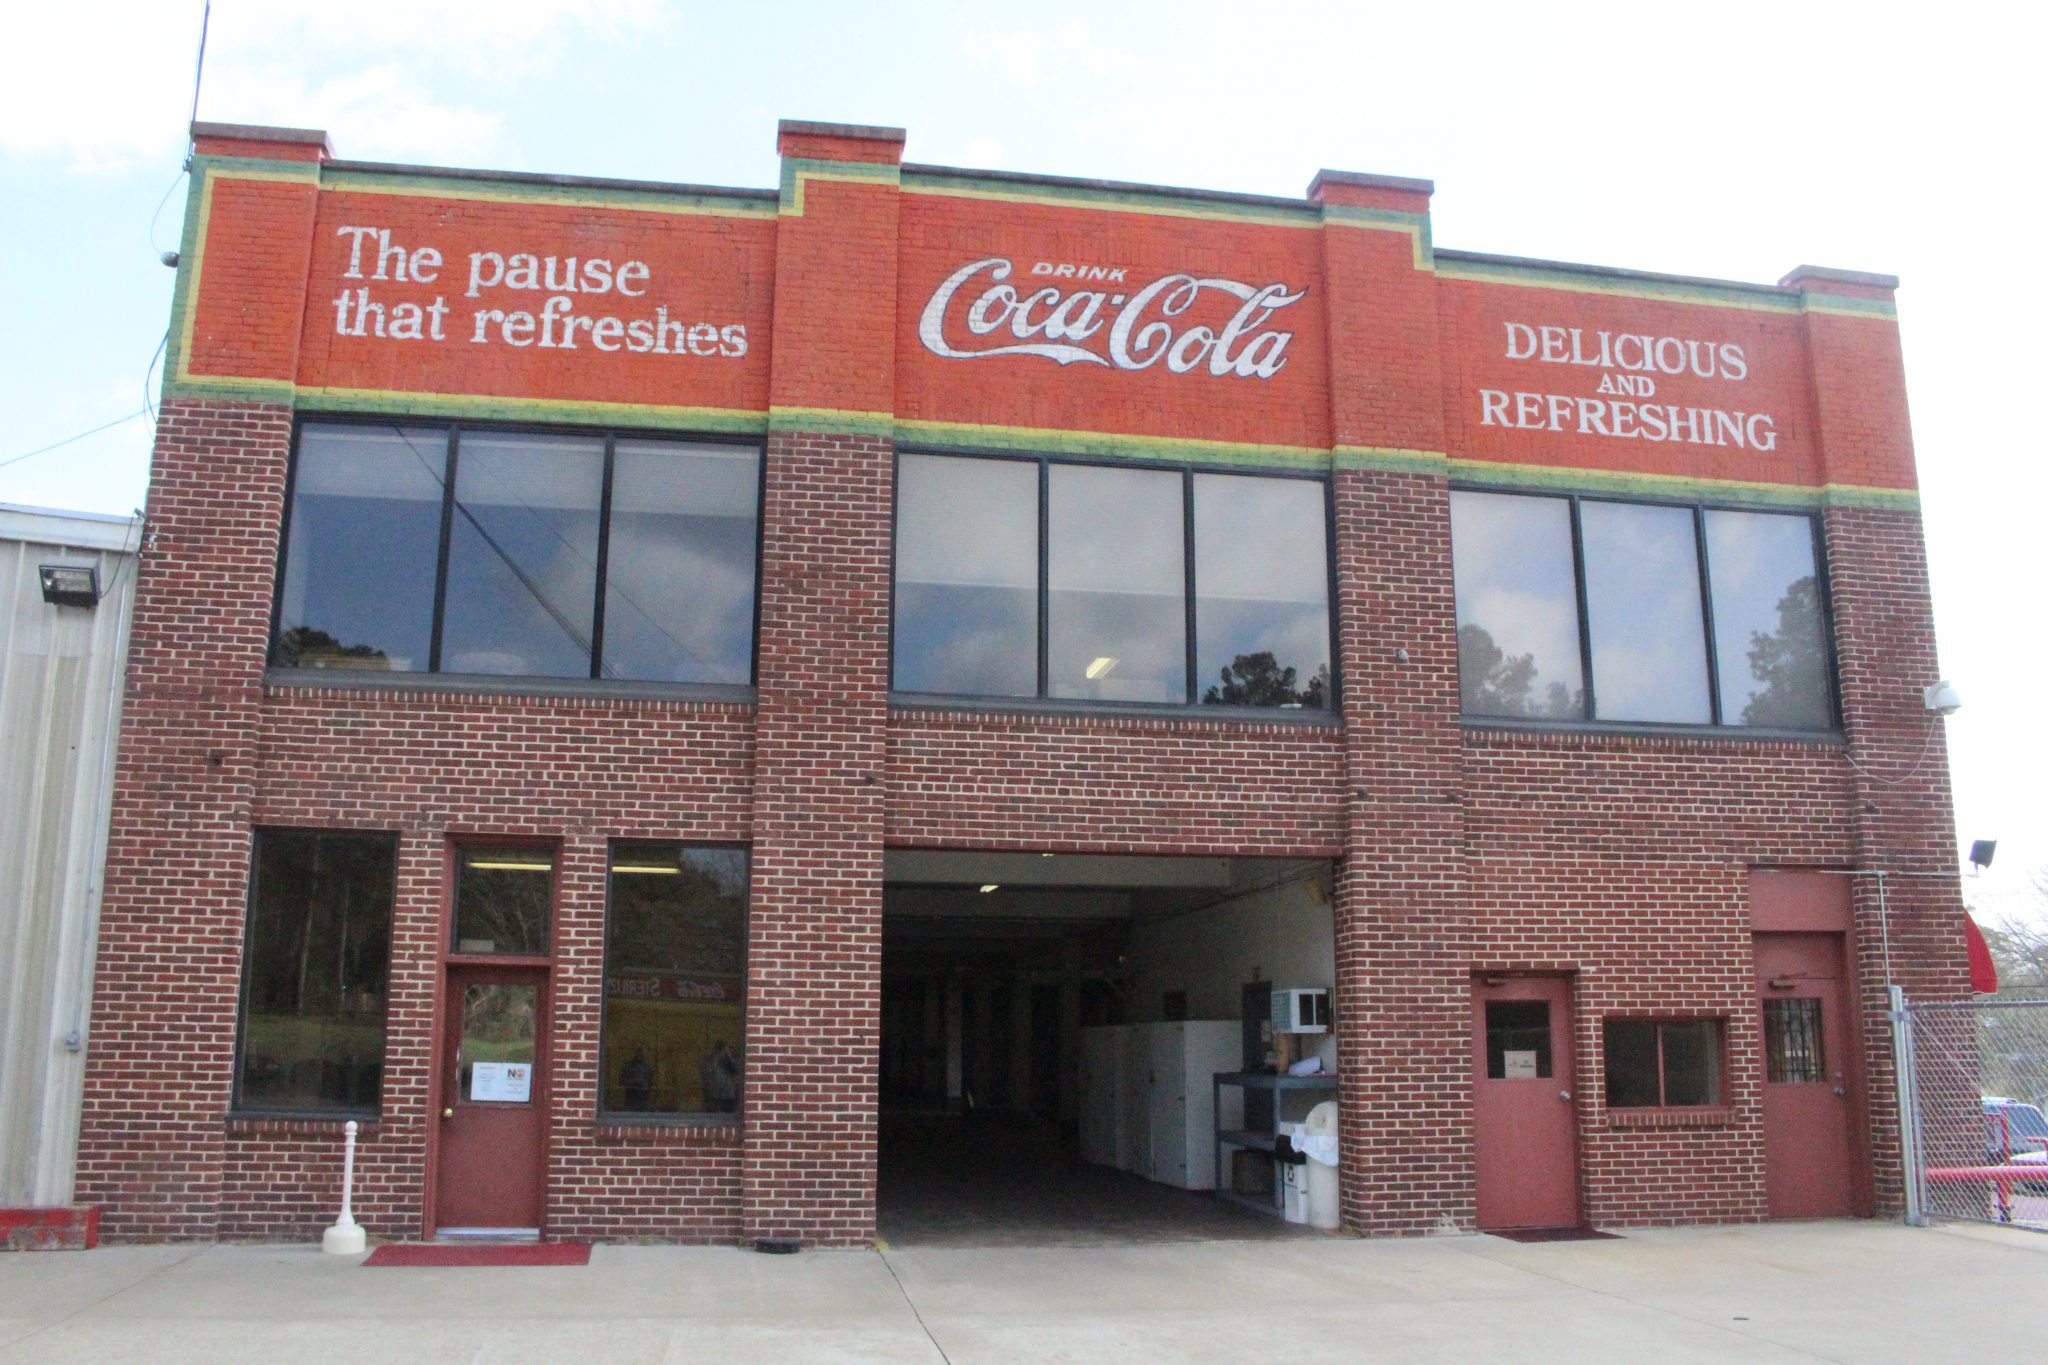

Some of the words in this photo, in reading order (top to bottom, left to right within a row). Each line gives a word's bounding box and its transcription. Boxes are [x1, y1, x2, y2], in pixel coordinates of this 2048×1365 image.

[337, 225, 443, 283] The
[464, 251, 650, 297] pause
[1031, 262, 1129, 283] DRINK
[333, 287, 450, 341] that
[470, 296, 748, 357] refreshes
[918, 257, 1306, 379] Coca-Cola
[1503, 322, 1747, 380] DELICIOUS
[1596, 372, 1656, 397] AND
[1479, 389, 1777, 451] REFRESHING
